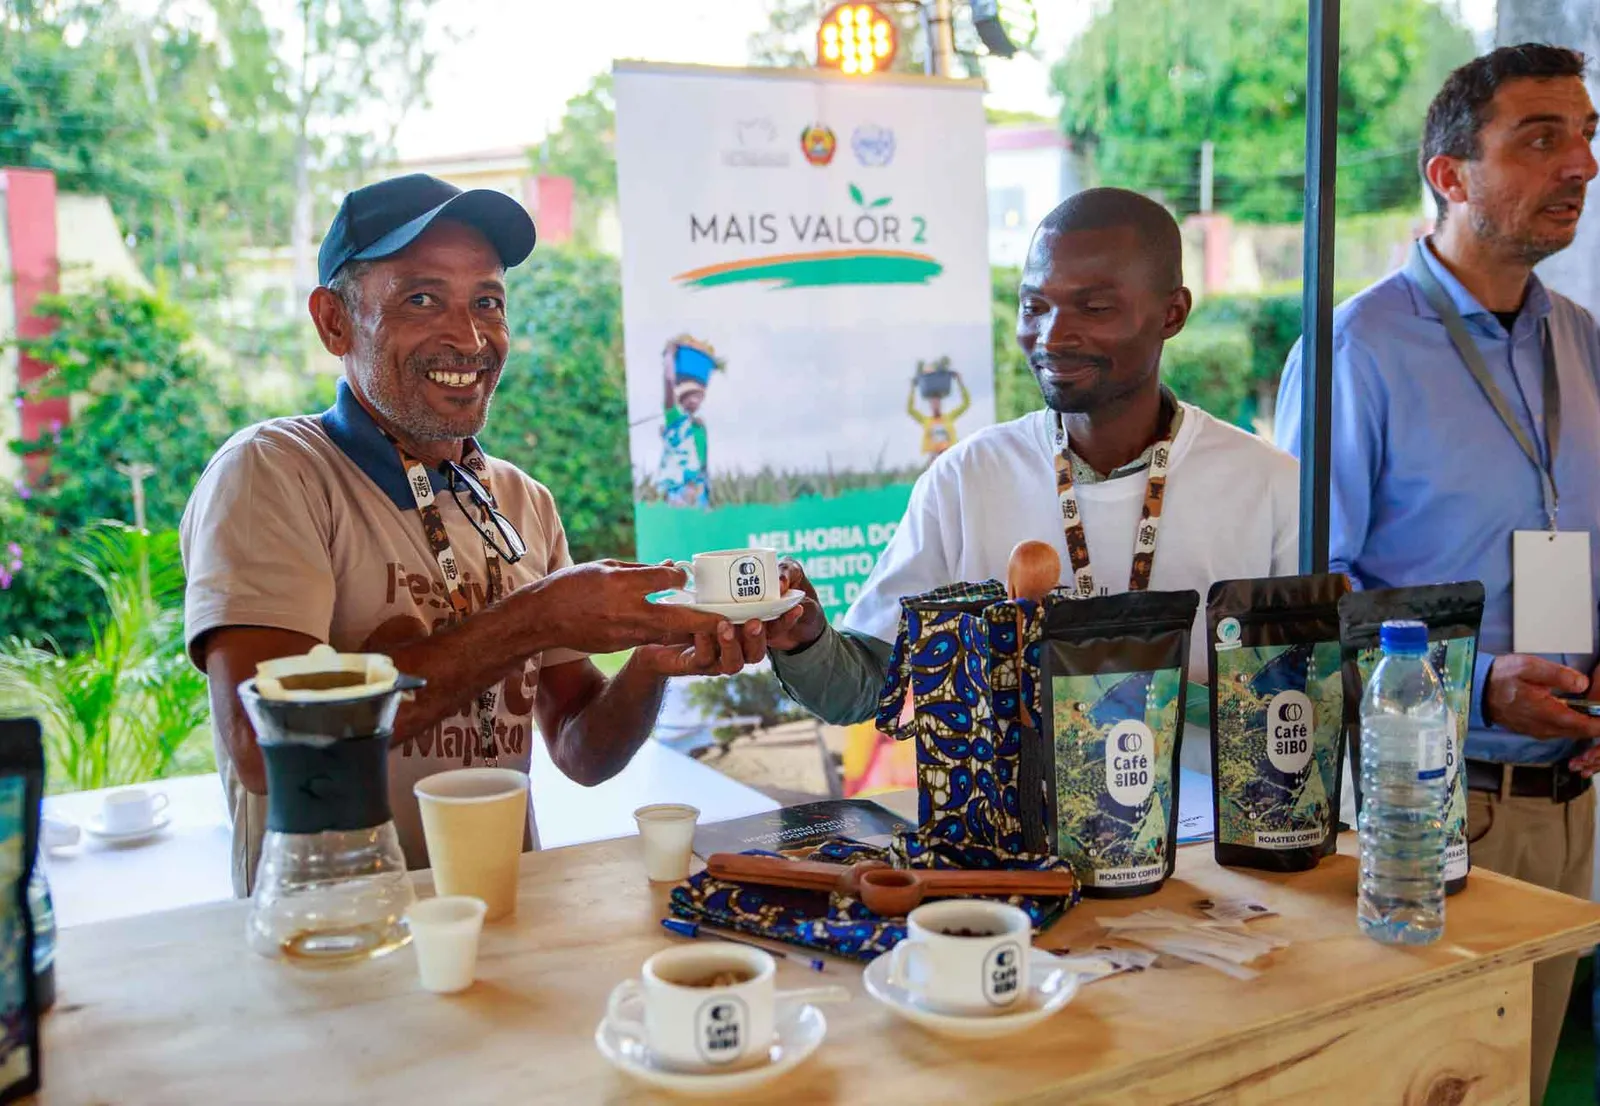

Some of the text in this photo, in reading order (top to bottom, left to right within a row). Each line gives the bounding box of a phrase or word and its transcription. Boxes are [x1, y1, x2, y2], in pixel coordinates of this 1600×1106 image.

[690, 210, 928, 244] MAIS VALOR 2
[749, 525, 865, 552] MELHORIA
[803, 552, 874, 580] MENTO
[736, 575, 760, 587] Café
[744, 585, 761, 597] IBO
[1274, 723, 1308, 740] Café
[1284, 739, 1308, 755] IBO
[1113, 754, 1148, 771] Café
[1124, 770, 1148, 787] IBO
[1258, 831, 1321, 843] ROASTED COFFEE
[1099, 871, 1137, 881] ROASTED
